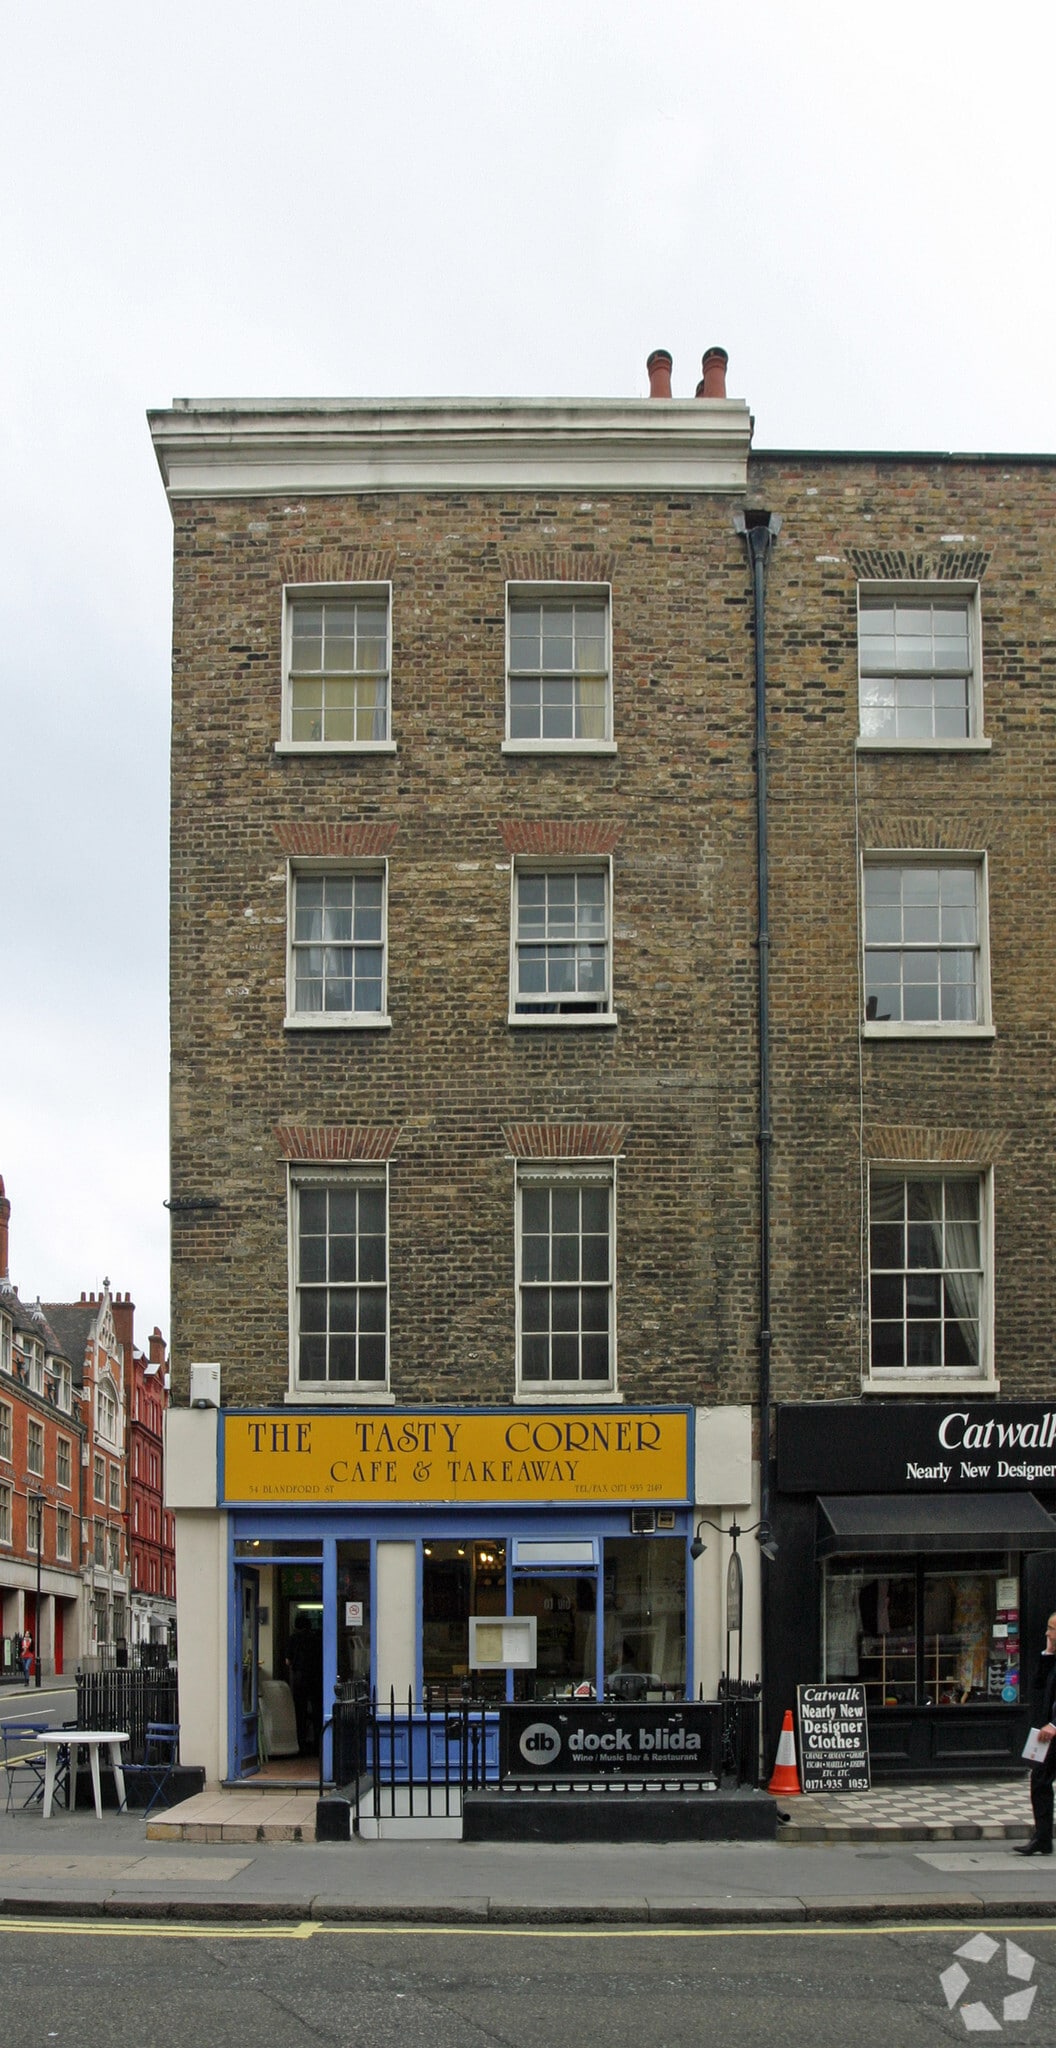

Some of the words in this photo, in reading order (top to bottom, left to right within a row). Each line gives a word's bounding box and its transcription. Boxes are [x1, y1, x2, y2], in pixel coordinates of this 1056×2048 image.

[248, 1422, 312, 1453] THE
[355, 1422, 462, 1454] TASTY
[504, 1421, 663, 1453] CORNER
[329, 1461, 398, 1483] CAFE
[413, 1462, 433, 1482] &
[447, 1460, 580, 1482] TAKEAWAY
[905, 1462, 952, 1483] Nearly
[960, 1461, 991, 1478] New
[997, 1461, 1056, 1481] Designer
[263, 1485, 320, 1493] BLANDFORD
[324, 1485, 334, 1493] ST
[611, 1484, 627, 1493] 0171
[804, 1688, 860, 1701] Catwalk
[802, 1704, 836, 1720] Nearly
[840, 1704, 863, 1718] New
[804, 1720, 863, 1737] Designer
[525, 1733, 555, 1751] db
[568, 1728, 633, 1751] dock
[639, 1727, 702, 1751] blida
[808, 1735, 860, 1749] Clothes
[572, 1753, 593, 1762] Wine
[600, 1753, 624, 1762] Music
[626, 1753, 641, 1761] Bar
[643, 1753, 650, 1761] &
[652, 1753, 698, 1761] Restaurant
[805, 1779, 842, 1789] 0171-935
[848, 1778, 868, 1789] 1052
